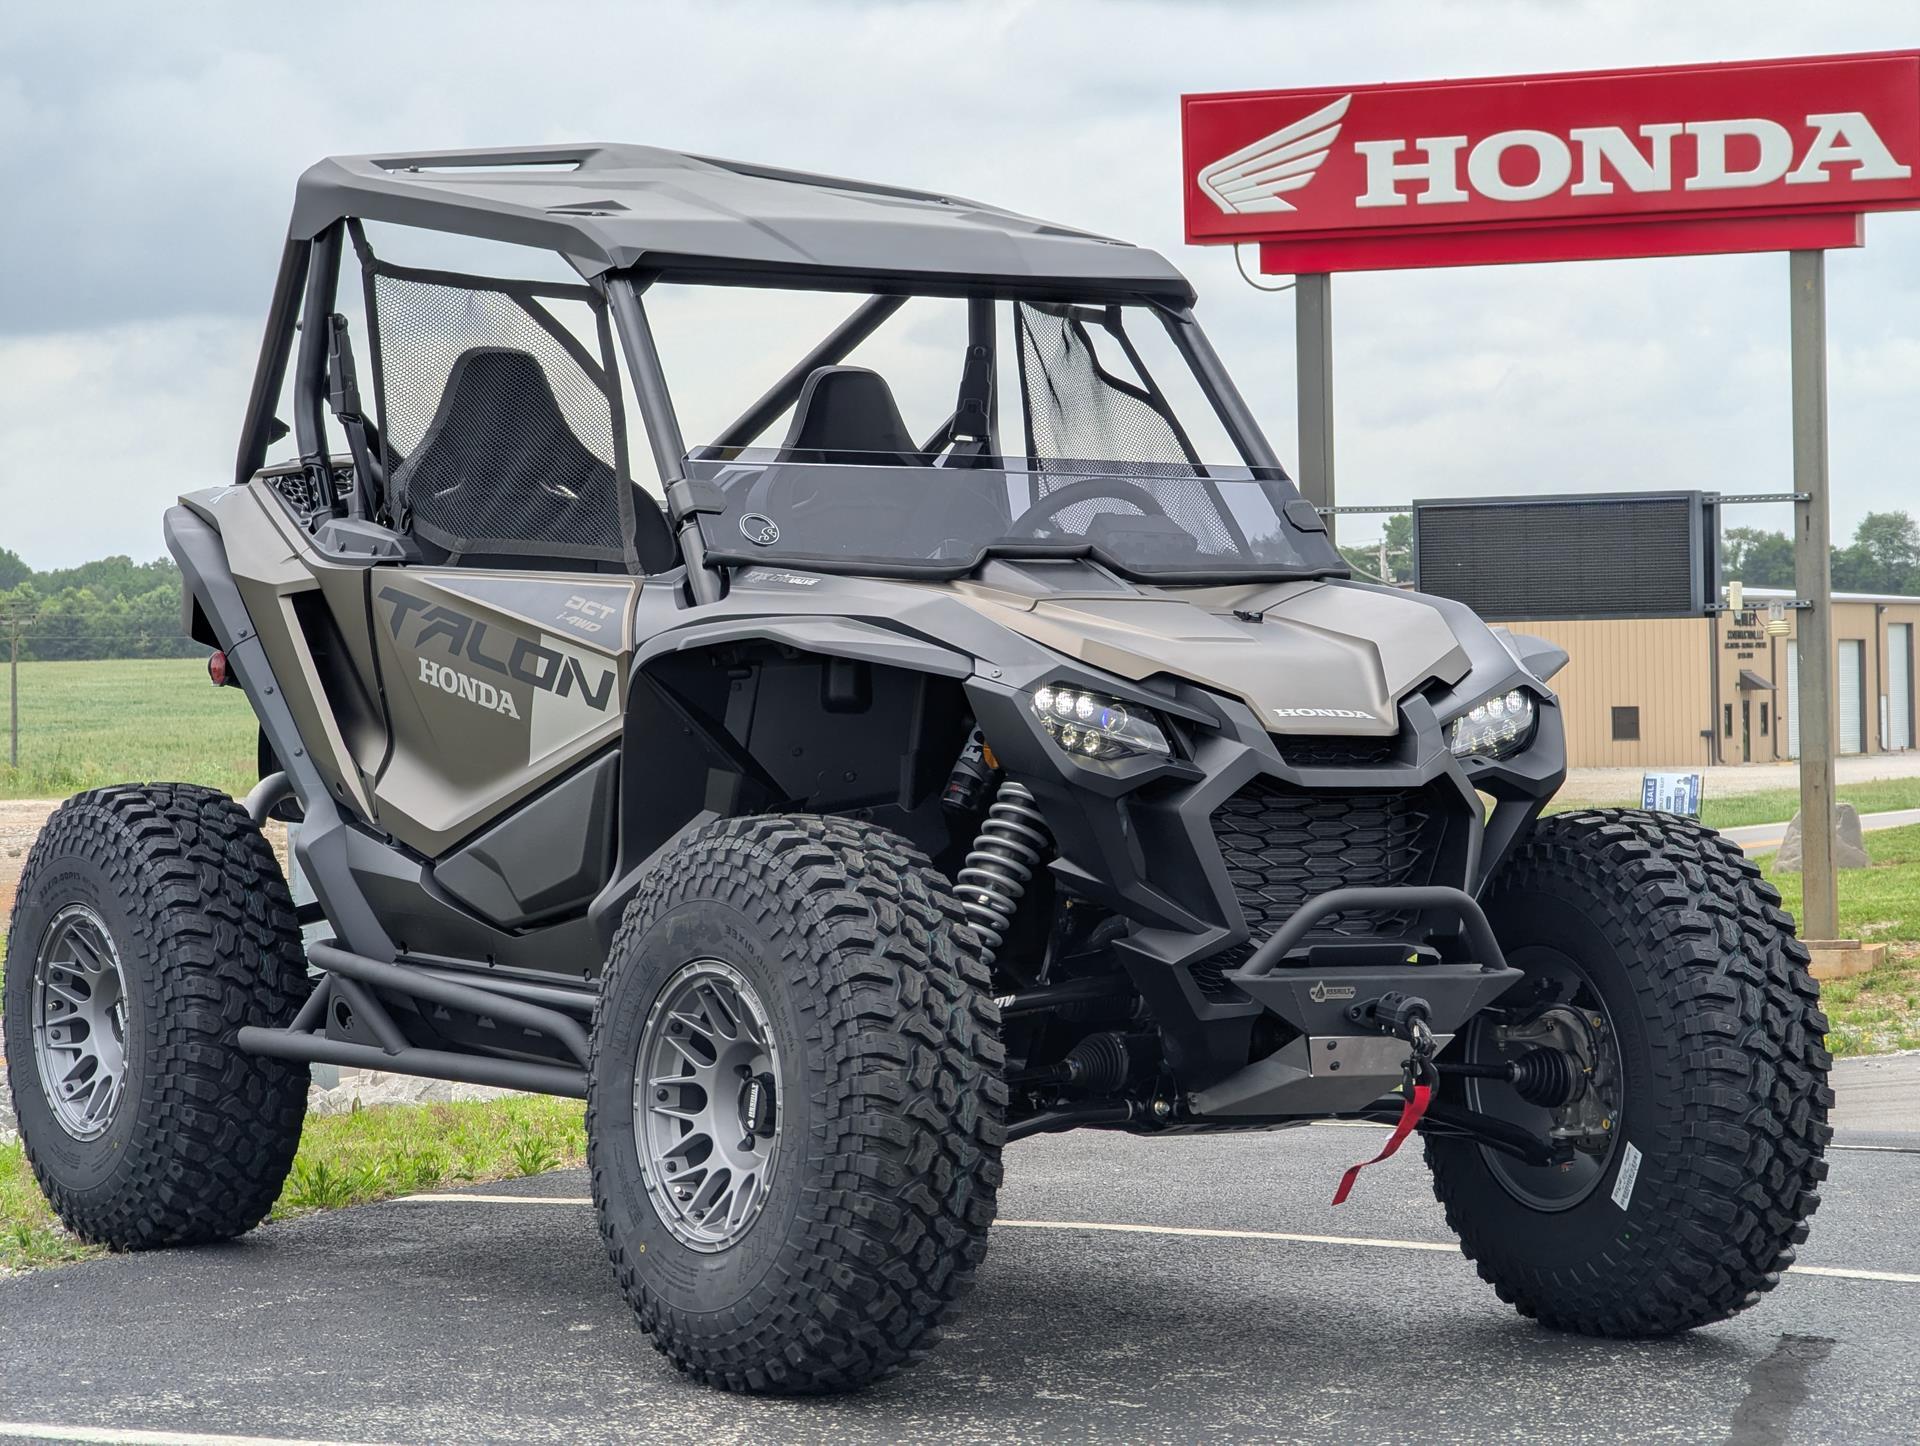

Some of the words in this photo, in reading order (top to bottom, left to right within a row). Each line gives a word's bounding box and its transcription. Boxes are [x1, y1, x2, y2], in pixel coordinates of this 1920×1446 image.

[1354, 111, 1912, 208] HONDA
[565, 595, 616, 620] DCT
[377, 586, 617, 712] TALON
[418, 657, 521, 721] HONDA
[1272, 708, 1376, 720] HONDA
